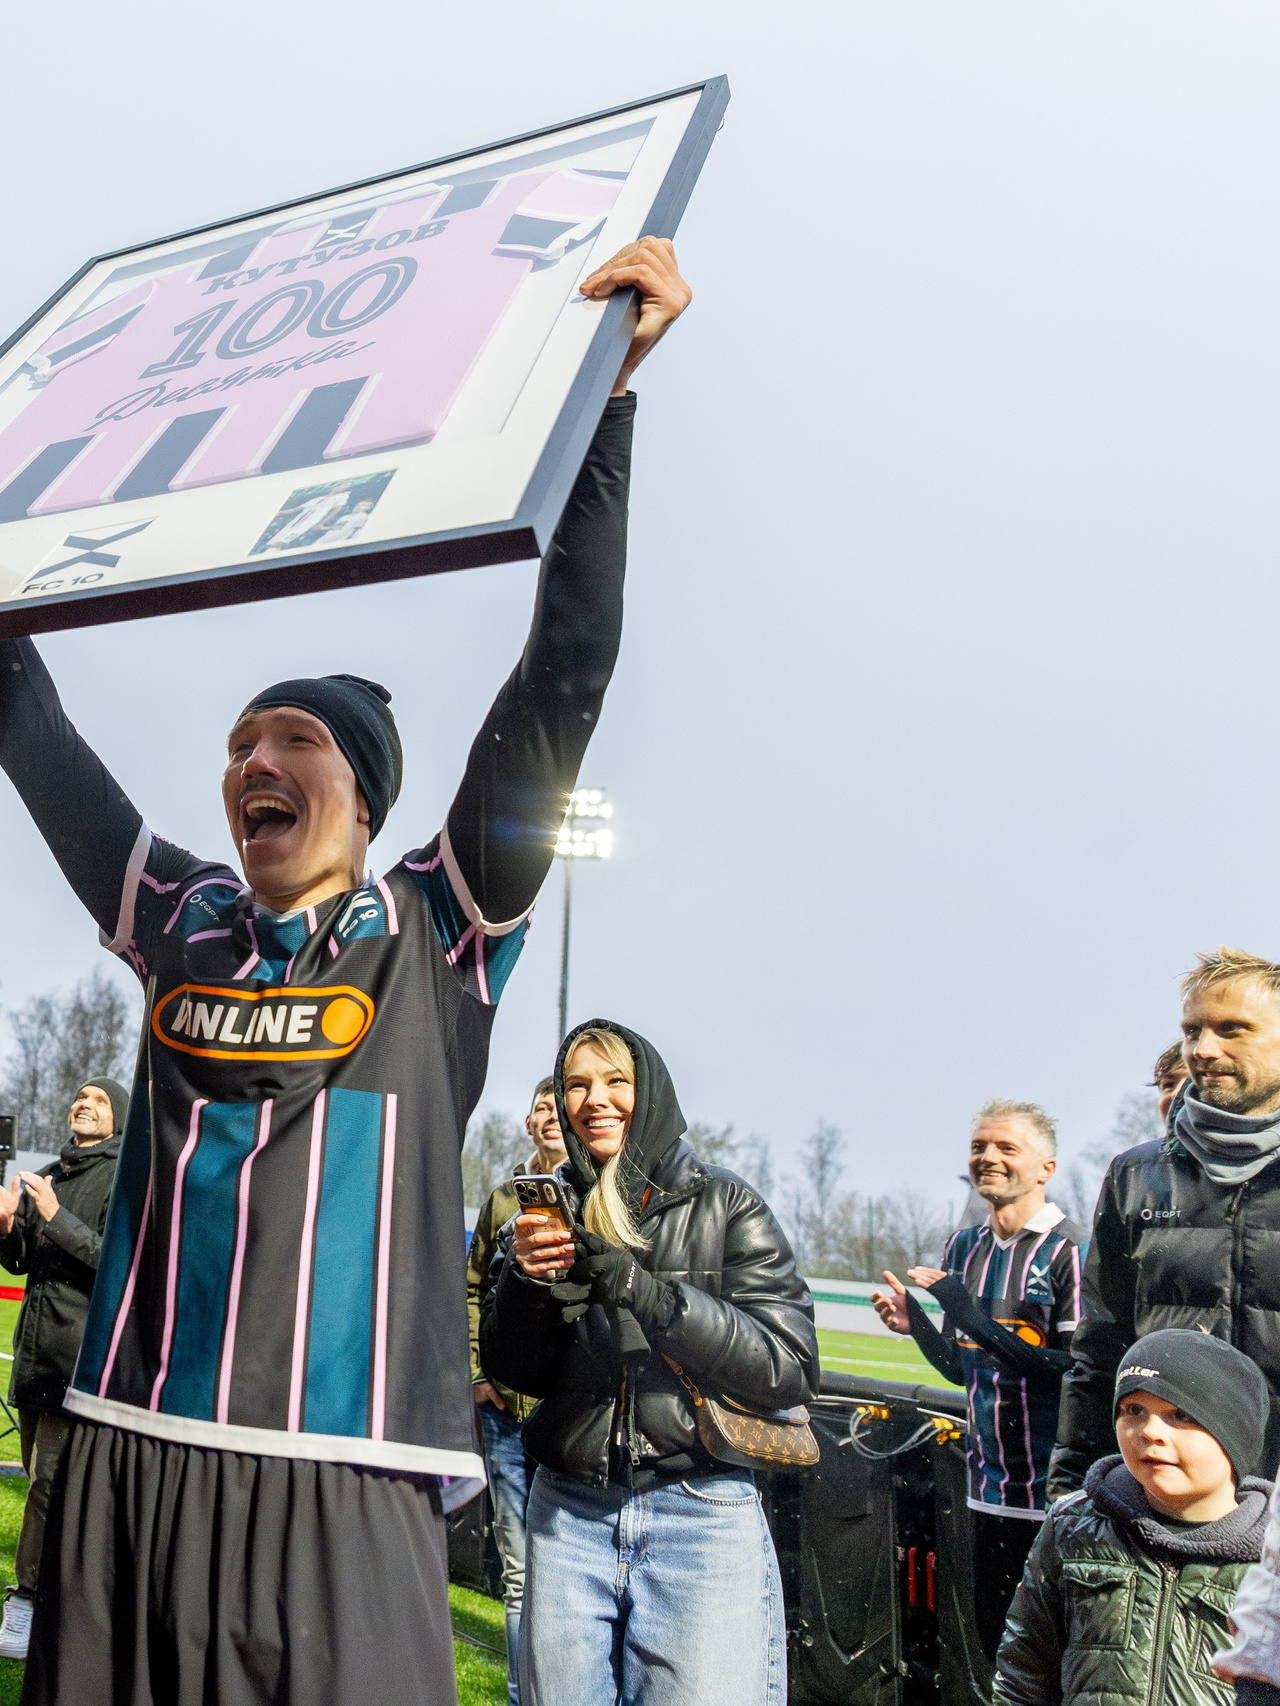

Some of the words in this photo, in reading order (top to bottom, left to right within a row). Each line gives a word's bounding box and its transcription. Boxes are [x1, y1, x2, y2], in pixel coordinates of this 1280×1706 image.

[201, 219, 450, 297] КУТУЗОВ
[137, 256, 419, 380] 100
[21, 580, 65, 594] FC
[71, 573, 105, 586] 10
[359, 909, 379, 921] 10
[1155, 1210, 1181, 1218] EQPT
